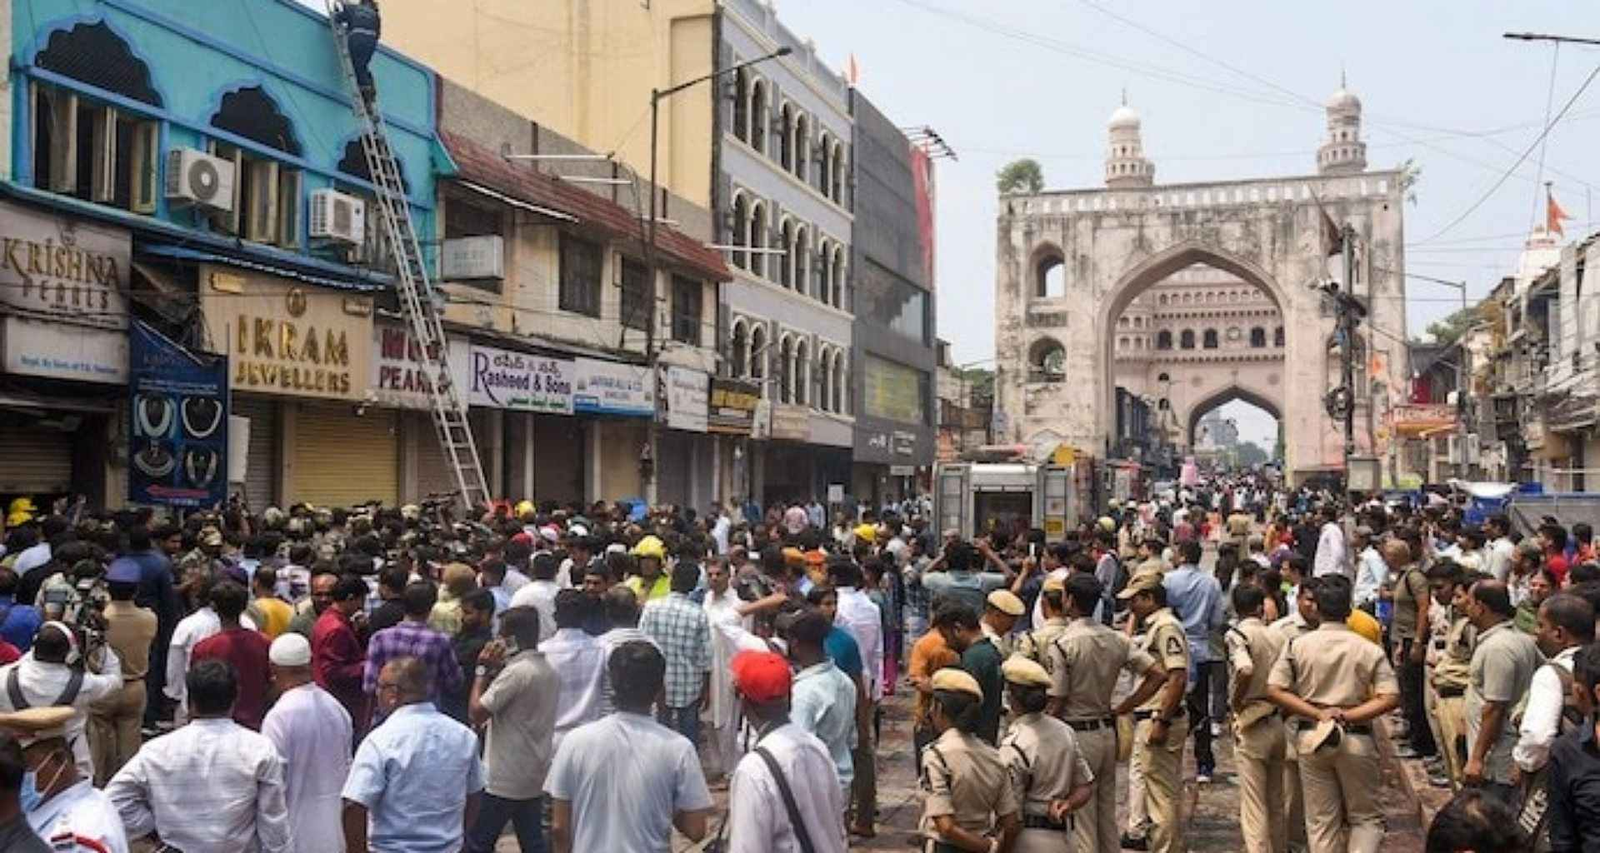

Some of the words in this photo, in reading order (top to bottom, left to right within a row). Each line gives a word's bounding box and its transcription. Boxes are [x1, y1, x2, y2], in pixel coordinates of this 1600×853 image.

[22, 278, 109, 309] PEARLS
[238, 314, 349, 367] IKRAM
[235, 361, 349, 393] JEWELLERS
[472, 352, 529, 404] Rasheed
[534, 373, 541, 391] &
[545, 375, 571, 394] Sons
